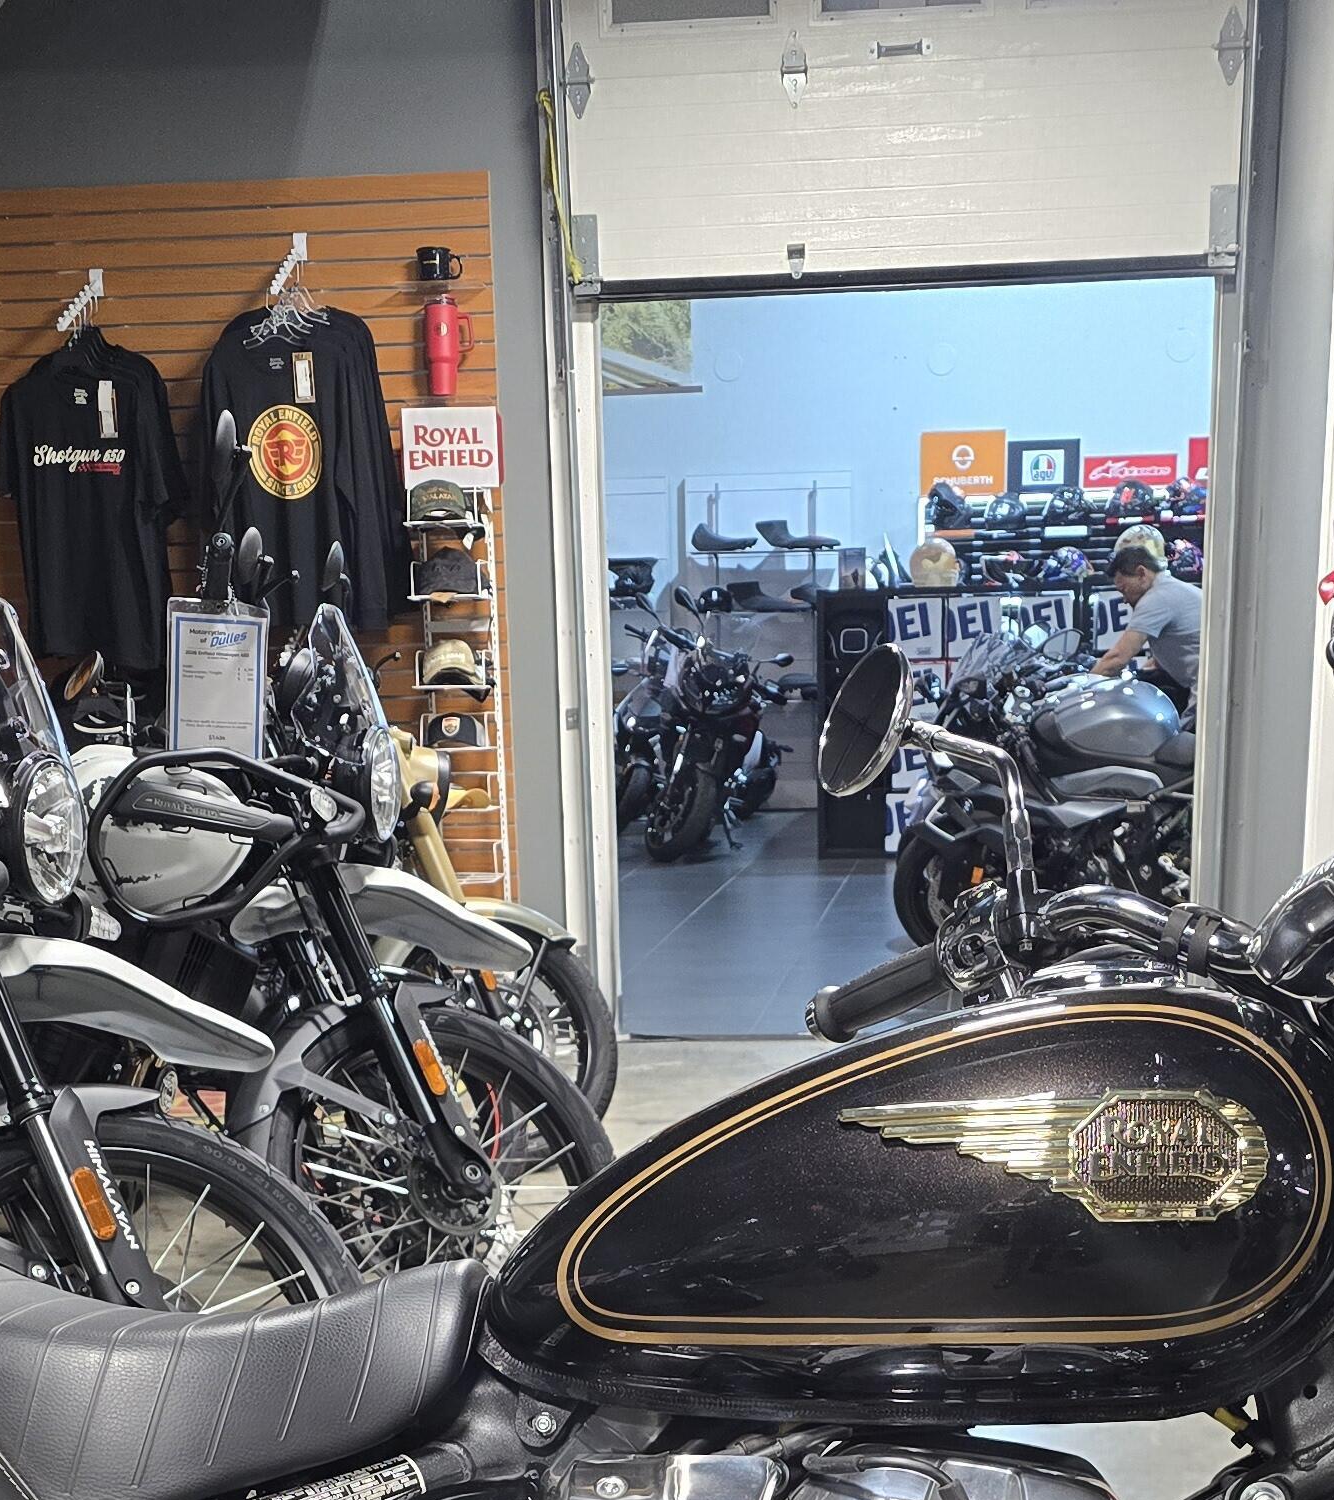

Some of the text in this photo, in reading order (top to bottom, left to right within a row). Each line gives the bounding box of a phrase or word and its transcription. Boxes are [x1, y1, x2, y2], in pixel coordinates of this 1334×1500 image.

[251, 409, 319, 447] ROYAL ENFIELD
[413, 424, 483, 448] ROYAL
[33, 444, 102, 473] Shotgun
[103, 449, 126, 463] 650
[409, 449, 494, 472] ENFIELD
[293, 474, 316, 494] 1901
[189, 628, 227, 636] Motorcycles
[210, 632, 248, 648] Dulles
[1101, 1115, 1214, 1149] ROYAL
[1088, 1150, 1225, 1183] ENFIELD
[83, 1139, 140, 1250] HIMALAYAN
